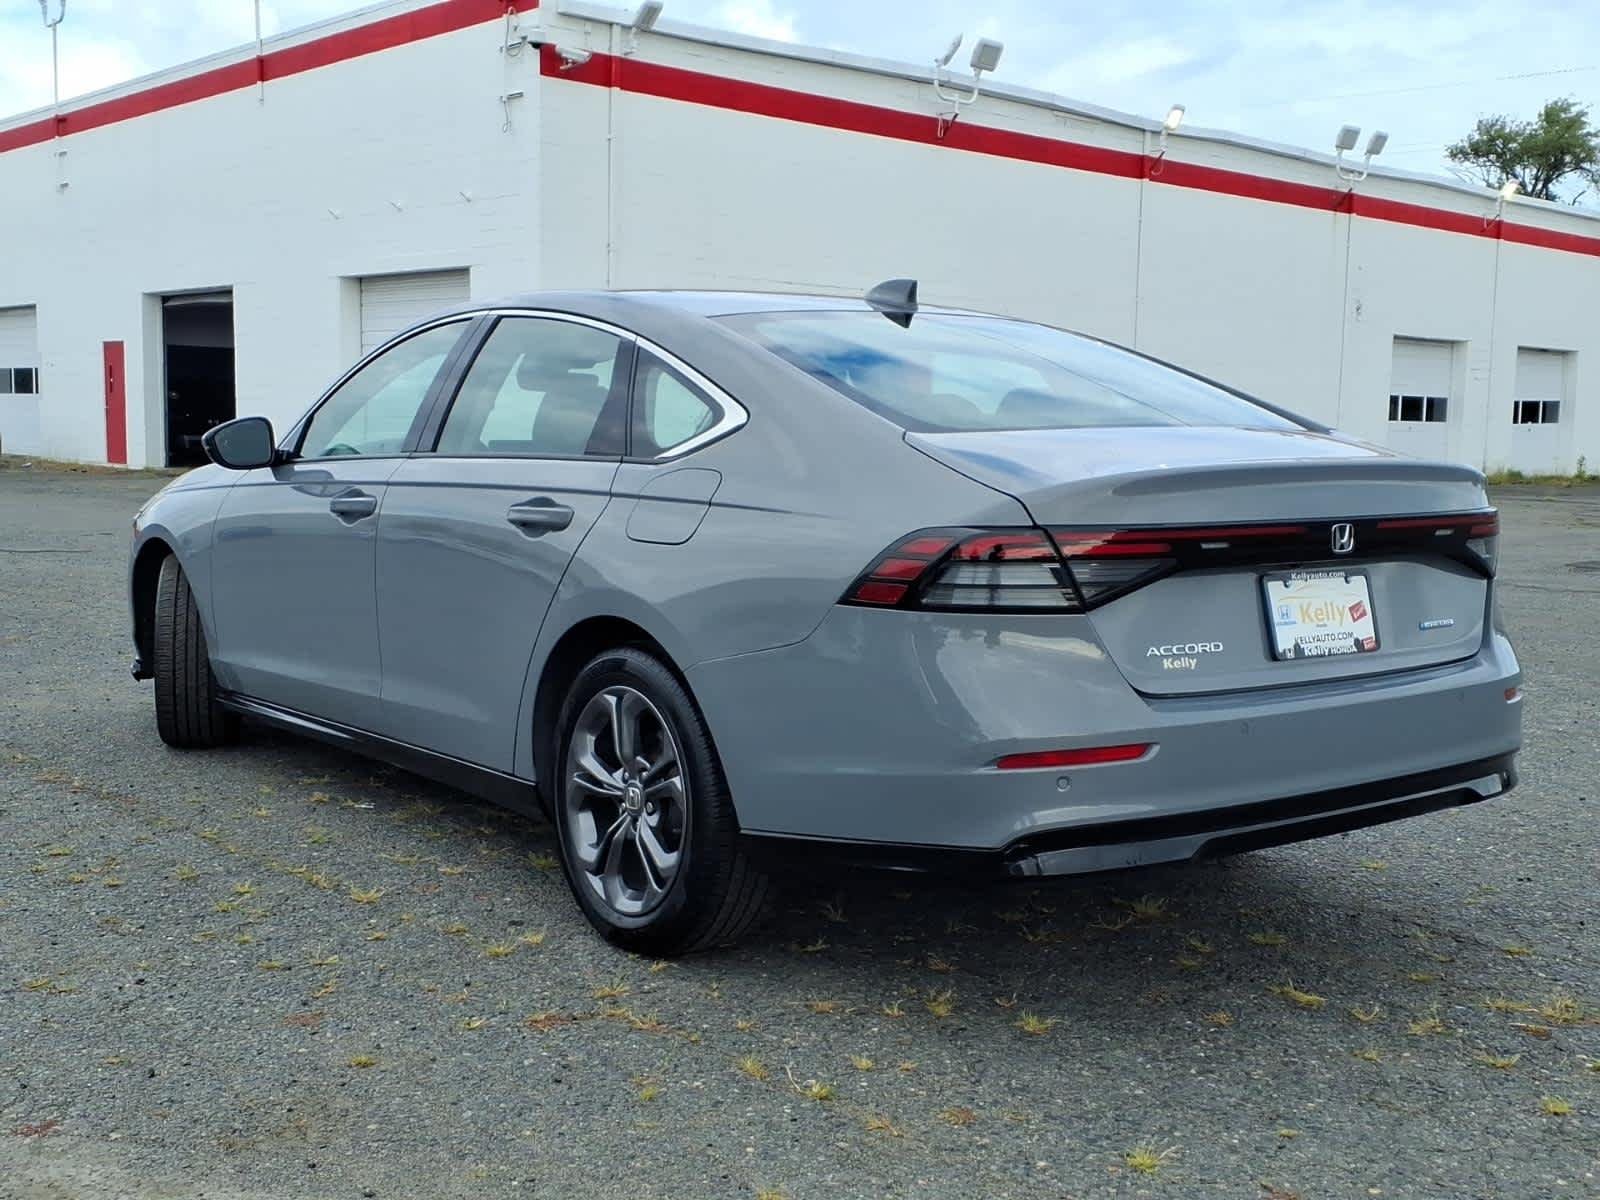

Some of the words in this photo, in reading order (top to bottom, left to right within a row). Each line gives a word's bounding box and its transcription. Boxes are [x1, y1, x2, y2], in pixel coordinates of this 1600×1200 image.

[1291, 571, 1346, 582] Kellyauto.com
[1299, 601, 1346, 627] Kelly
[1295, 632, 1354, 645] KELLYAUTO.COM
[1146, 642, 1223, 657] ACCORD
[1162, 656, 1197, 670] Kelly
